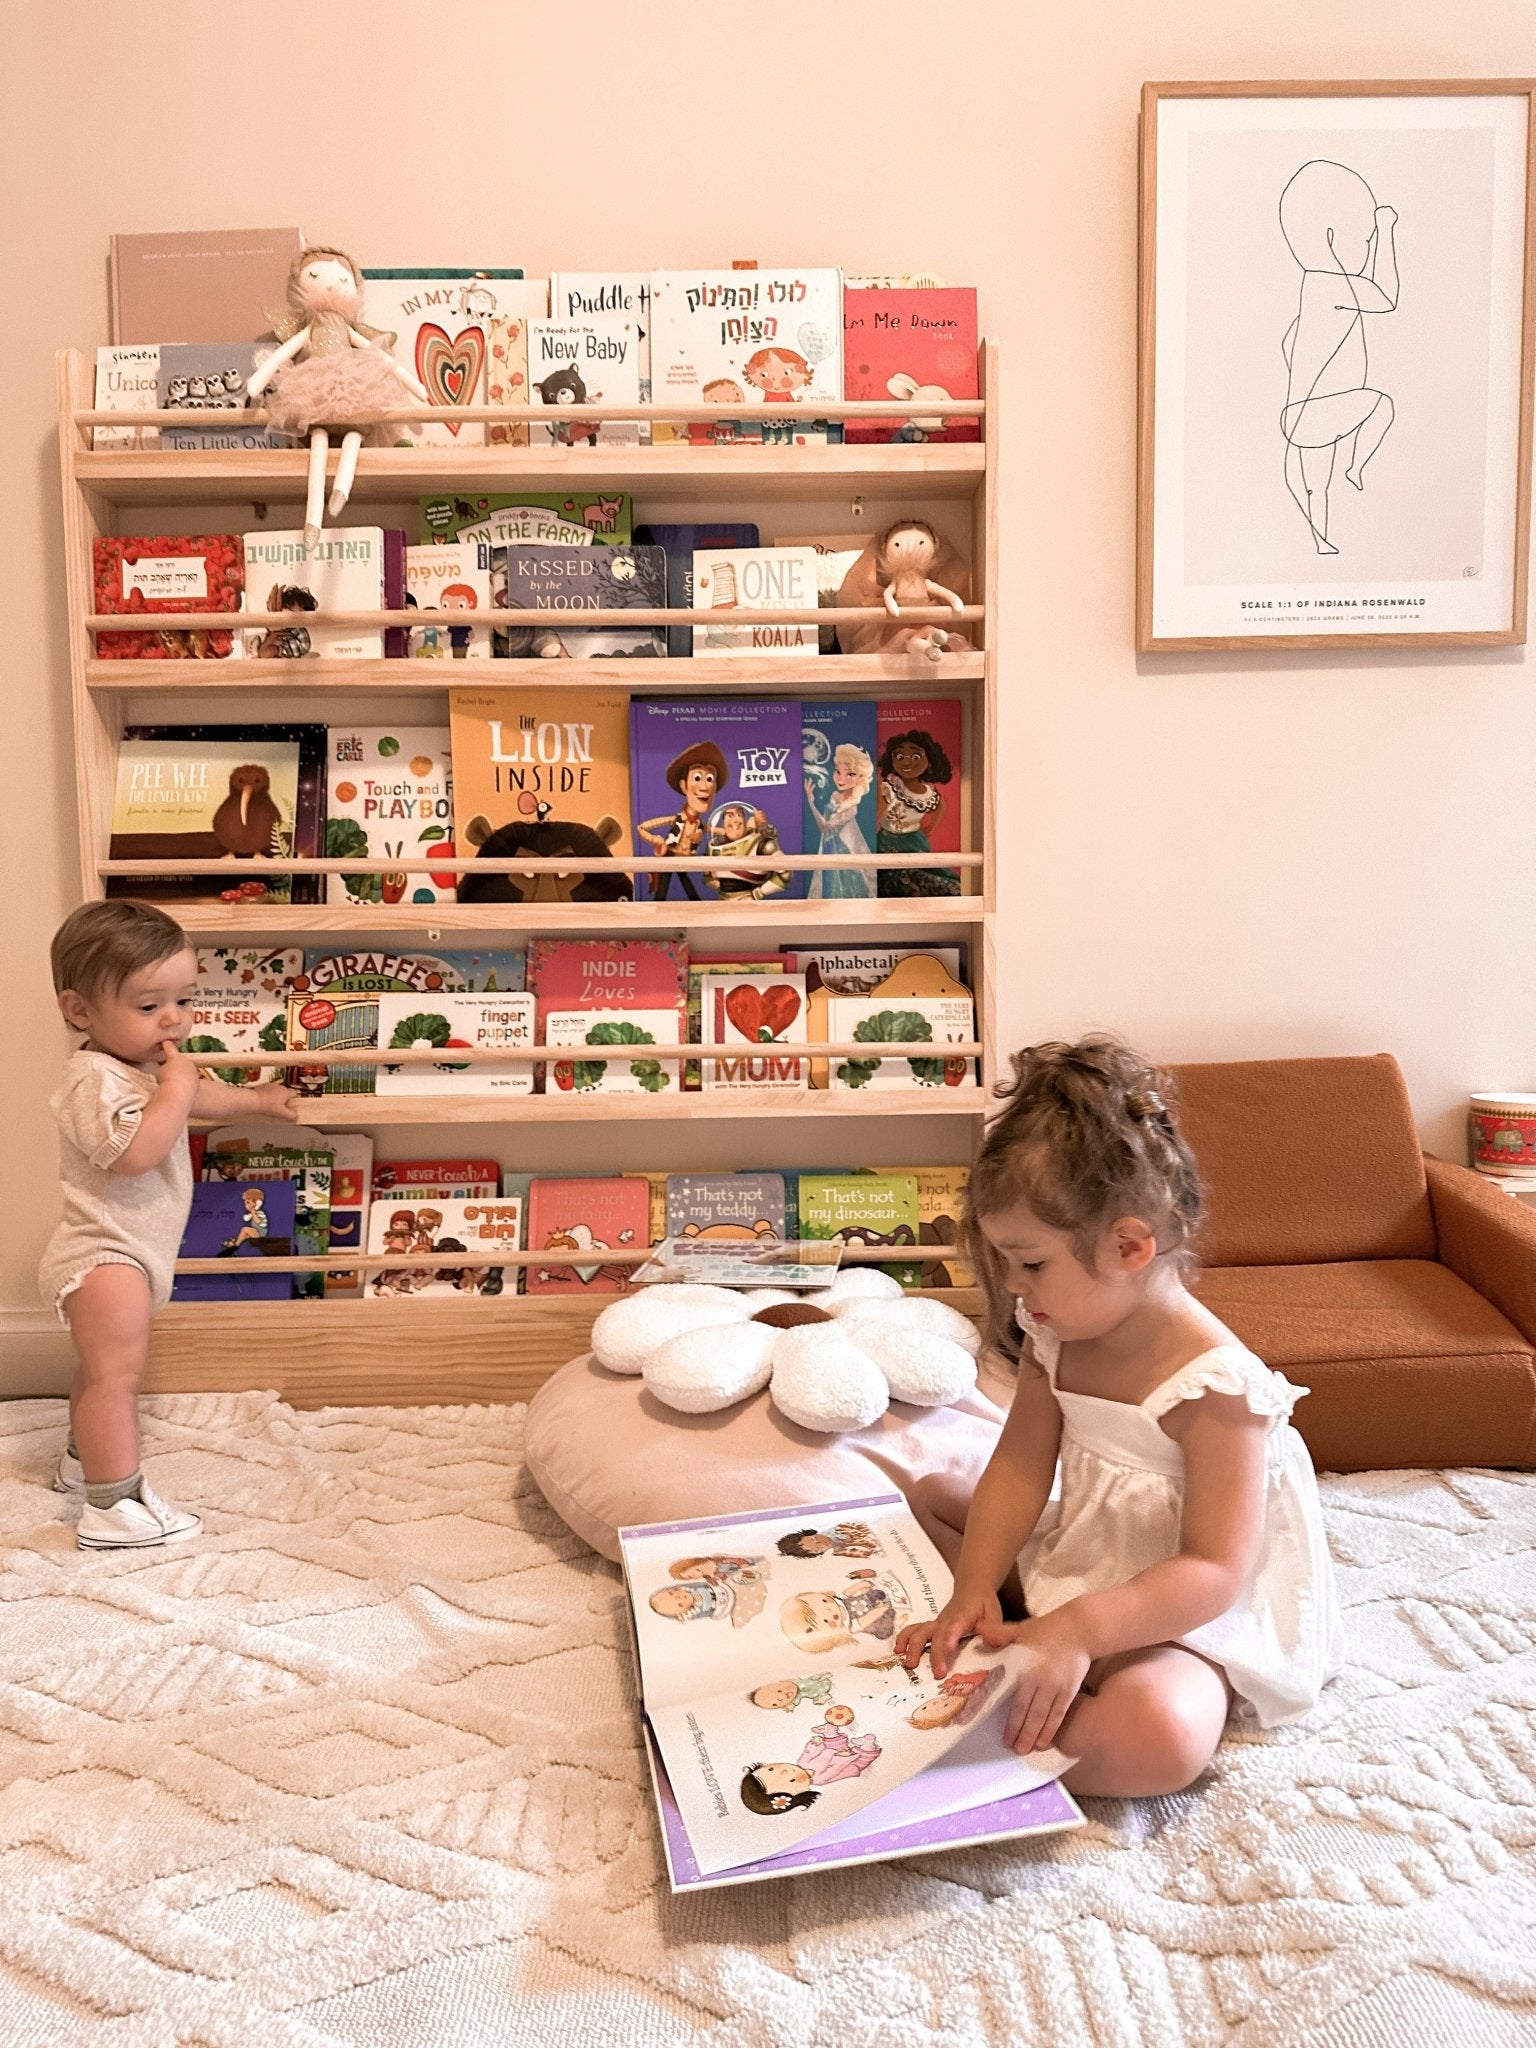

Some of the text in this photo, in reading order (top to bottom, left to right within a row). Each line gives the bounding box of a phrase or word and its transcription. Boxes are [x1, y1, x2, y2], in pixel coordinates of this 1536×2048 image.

[400, 289, 454, 316] IN MY
[843, 312, 958, 329] lm Me Down
[112, 350, 159, 364] Slumberk
[541, 335, 628, 364] New Baby
[107, 371, 159, 391] Unico
[169, 435, 280, 450] Ten Little Owls
[496, 522, 531, 540] THE
[537, 522, 586, 545] FARM
[530, 580, 562, 592] by the
[742, 559, 804, 600] ONE
[536, 595, 600, 609] MOON
[1241, 601, 1273, 609] SCALE
[1296, 600, 1310, 608] OF
[1362, 598, 1426, 606] ROSENWALD
[752, 626, 804, 648] KOALA
[647, 705, 669, 716] Disney
[700, 706, 727, 714] MOVIE
[731, 705, 788, 714] COLLECTION
[802, 710, 848, 718] LLECTION
[519, 714, 536, 730] THE
[336, 739, 364, 752] ERIC
[488, 720, 595, 764] LION
[336, 752, 364, 762] CARLE
[737, 747, 791, 772] TOY
[130, 763, 210, 789] PEE WEE
[495, 765, 592, 793] INSIDE
[745, 774, 782, 782] STORY
[363, 780, 412, 796] Touch
[417, 783, 439, 795] and
[363, 798, 453, 820] PLAYBO
[311, 954, 428, 990] GIRAFFE
[582, 960, 637, 977] INDIE
[203, 987, 223, 998] Very
[226, 987, 258, 998] Hungry
[343, 979, 393, 990] is LOST
[579, 980, 635, 1002] Loves
[194, 1010, 213, 1025] DE
[223, 1010, 261, 1025] SEEK
[480, 1009, 526, 1026] finger
[477, 1025, 528, 1041] puppet
[714, 1057, 801, 1082] MUM
[247, 1152, 328, 1168] NEVER touch THE
[406, 1164, 489, 1182] NEVER touch A
[738, 1187, 763, 1201] not
[822, 1188, 895, 1204] That's not
[926, 1182, 950, 1195] not
[690, 1205, 712, 1221] my
[809, 1209, 832, 1224] my
[913, 1565, 928, 1583] clever
[921, 1583, 933, 1596] the
[924, 1597, 939, 1615] and
[702, 1765, 720, 1793] LOVE
[713, 1791, 730, 1819] Babies
